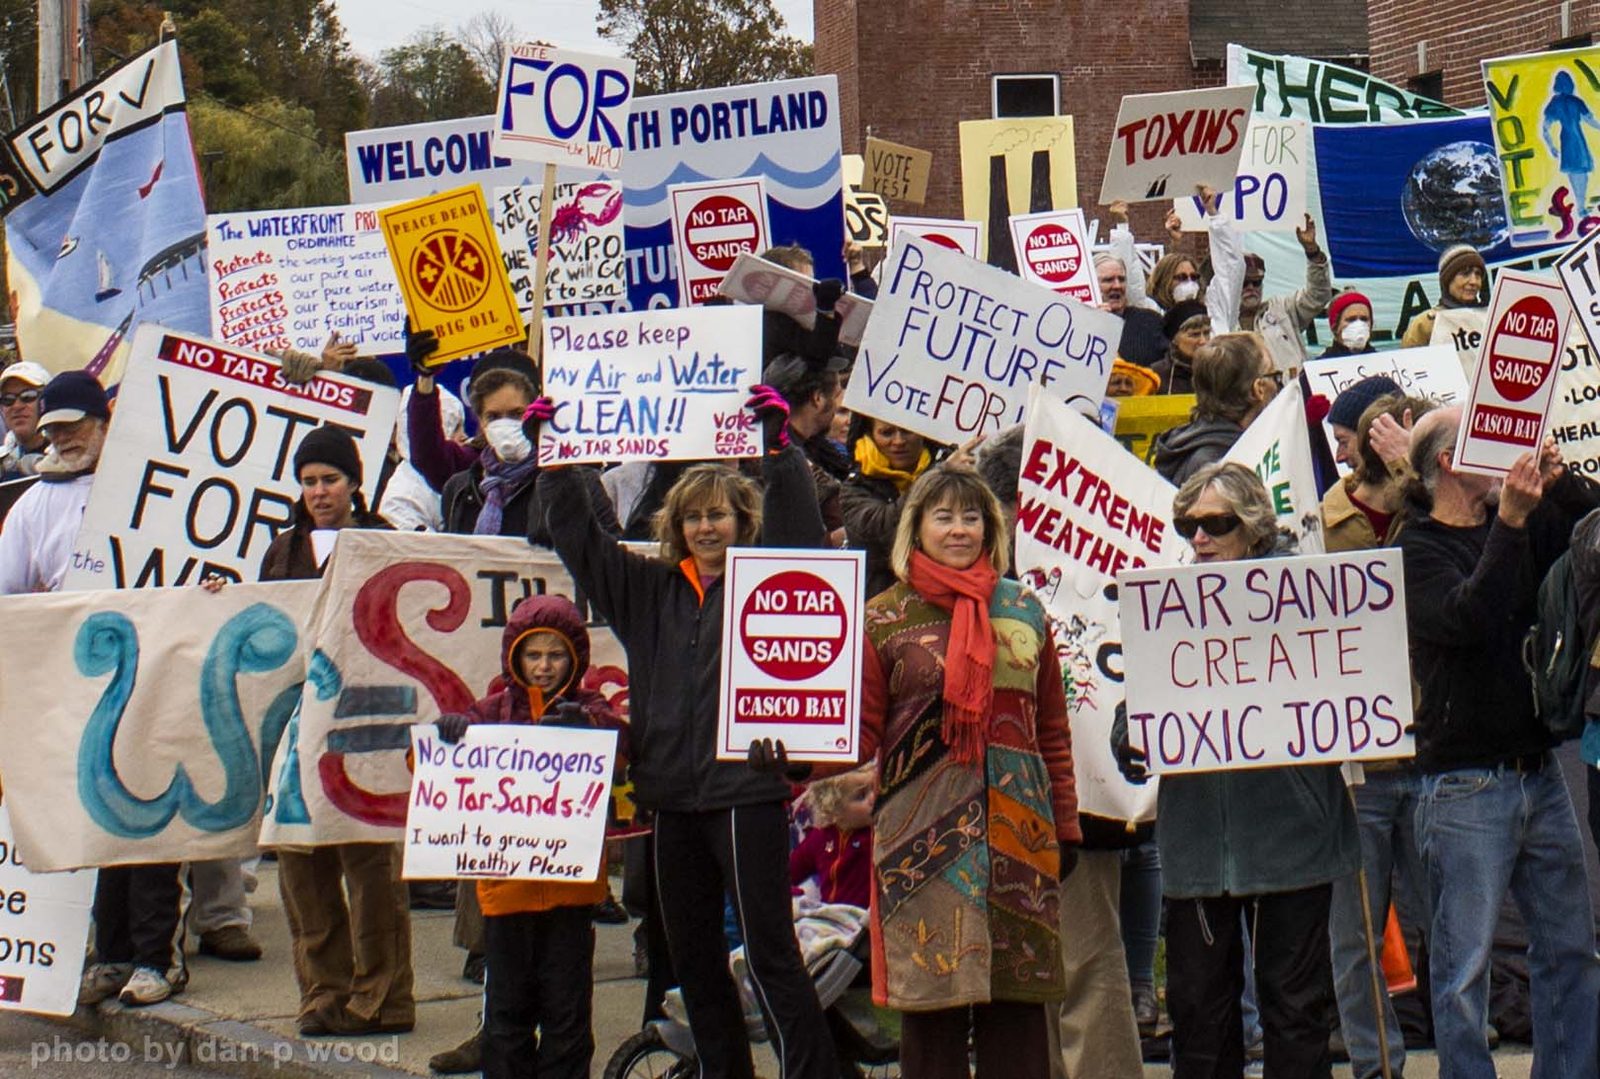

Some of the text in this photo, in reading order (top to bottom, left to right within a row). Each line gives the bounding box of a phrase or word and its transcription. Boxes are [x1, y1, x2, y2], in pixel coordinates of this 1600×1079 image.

[511, 45, 549, 60] VOTE
[502, 57, 630, 148] FOR
[28, 91, 111, 173] FOR
[671, 90, 828, 146] PORTLAND
[1117, 108, 1245, 166] TOXINS
[1252, 125, 1298, 166] FOR
[1486, 74, 1543, 226] VOTE
[872, 149, 912, 182] VOTE
[498, 187, 522, 214] IF
[215, 210, 381, 242] The WATERFRONT PRO
[392, 202, 477, 236] PEACE DEAD
[496, 205, 525, 235] YOU
[691, 205, 748, 227] NO TAR
[287, 235, 356, 251] ORDINANCE
[696, 241, 751, 261] SANDS
[1029, 232, 1072, 248] NO TAR
[213, 250, 273, 280] Protects
[1035, 259, 1077, 275] SANDS
[218, 266, 373, 301] Protects our pure air
[525, 286, 552, 302] ot
[556, 282, 576, 300] to
[692, 281, 723, 299] CAS
[219, 281, 394, 324] Protects our pure water
[220, 304, 288, 339] Protects
[294, 302, 319, 315] our
[329, 295, 388, 312] tourism
[890, 244, 1029, 337] PROTECT
[1035, 302, 1108, 376] OUR
[293, 318, 319, 331] our
[324, 313, 375, 331] fishing
[435, 310, 499, 339] BIG OIL
[550, 325, 629, 351] Please
[638, 321, 690, 349] keep
[1504, 311, 1556, 339] NO TAR
[296, 336, 322, 348] our
[176, 342, 216, 369] NO
[222, 353, 267, 382] TAR
[585, 358, 625, 389] Air
[636, 358, 662, 384] and
[668, 351, 747, 387] Water
[1493, 360, 1543, 386] SANDS
[865, 349, 931, 416] VOTE
[932, 375, 1006, 436] FOR
[551, 395, 687, 436] CLEAN!!
[1474, 411, 1539, 440] CASCO BAY
[584, 439, 611, 455] TAR
[617, 438, 669, 457] SANDS
[715, 431, 748, 446] FOR
[1552, 421, 1600, 445] HEAL
[129, 460, 296, 559] FOR
[1021, 439, 1166, 553] EXTREME
[73, 553, 105, 574] the
[754, 590, 835, 612] NO TAR
[1125, 560, 1394, 631] TAR SANDS
[752, 639, 832, 662] SANDS
[1171, 626, 1363, 689] CREATE
[738, 696, 844, 717] CASCO BAY
[1129, 694, 1403, 770] TOXIC JOBS
[418, 737, 446, 765] No
[416, 779, 447, 811] No
[411, 823, 567, 857] I want to grow up
[456, 852, 584, 878] Healthy Please
